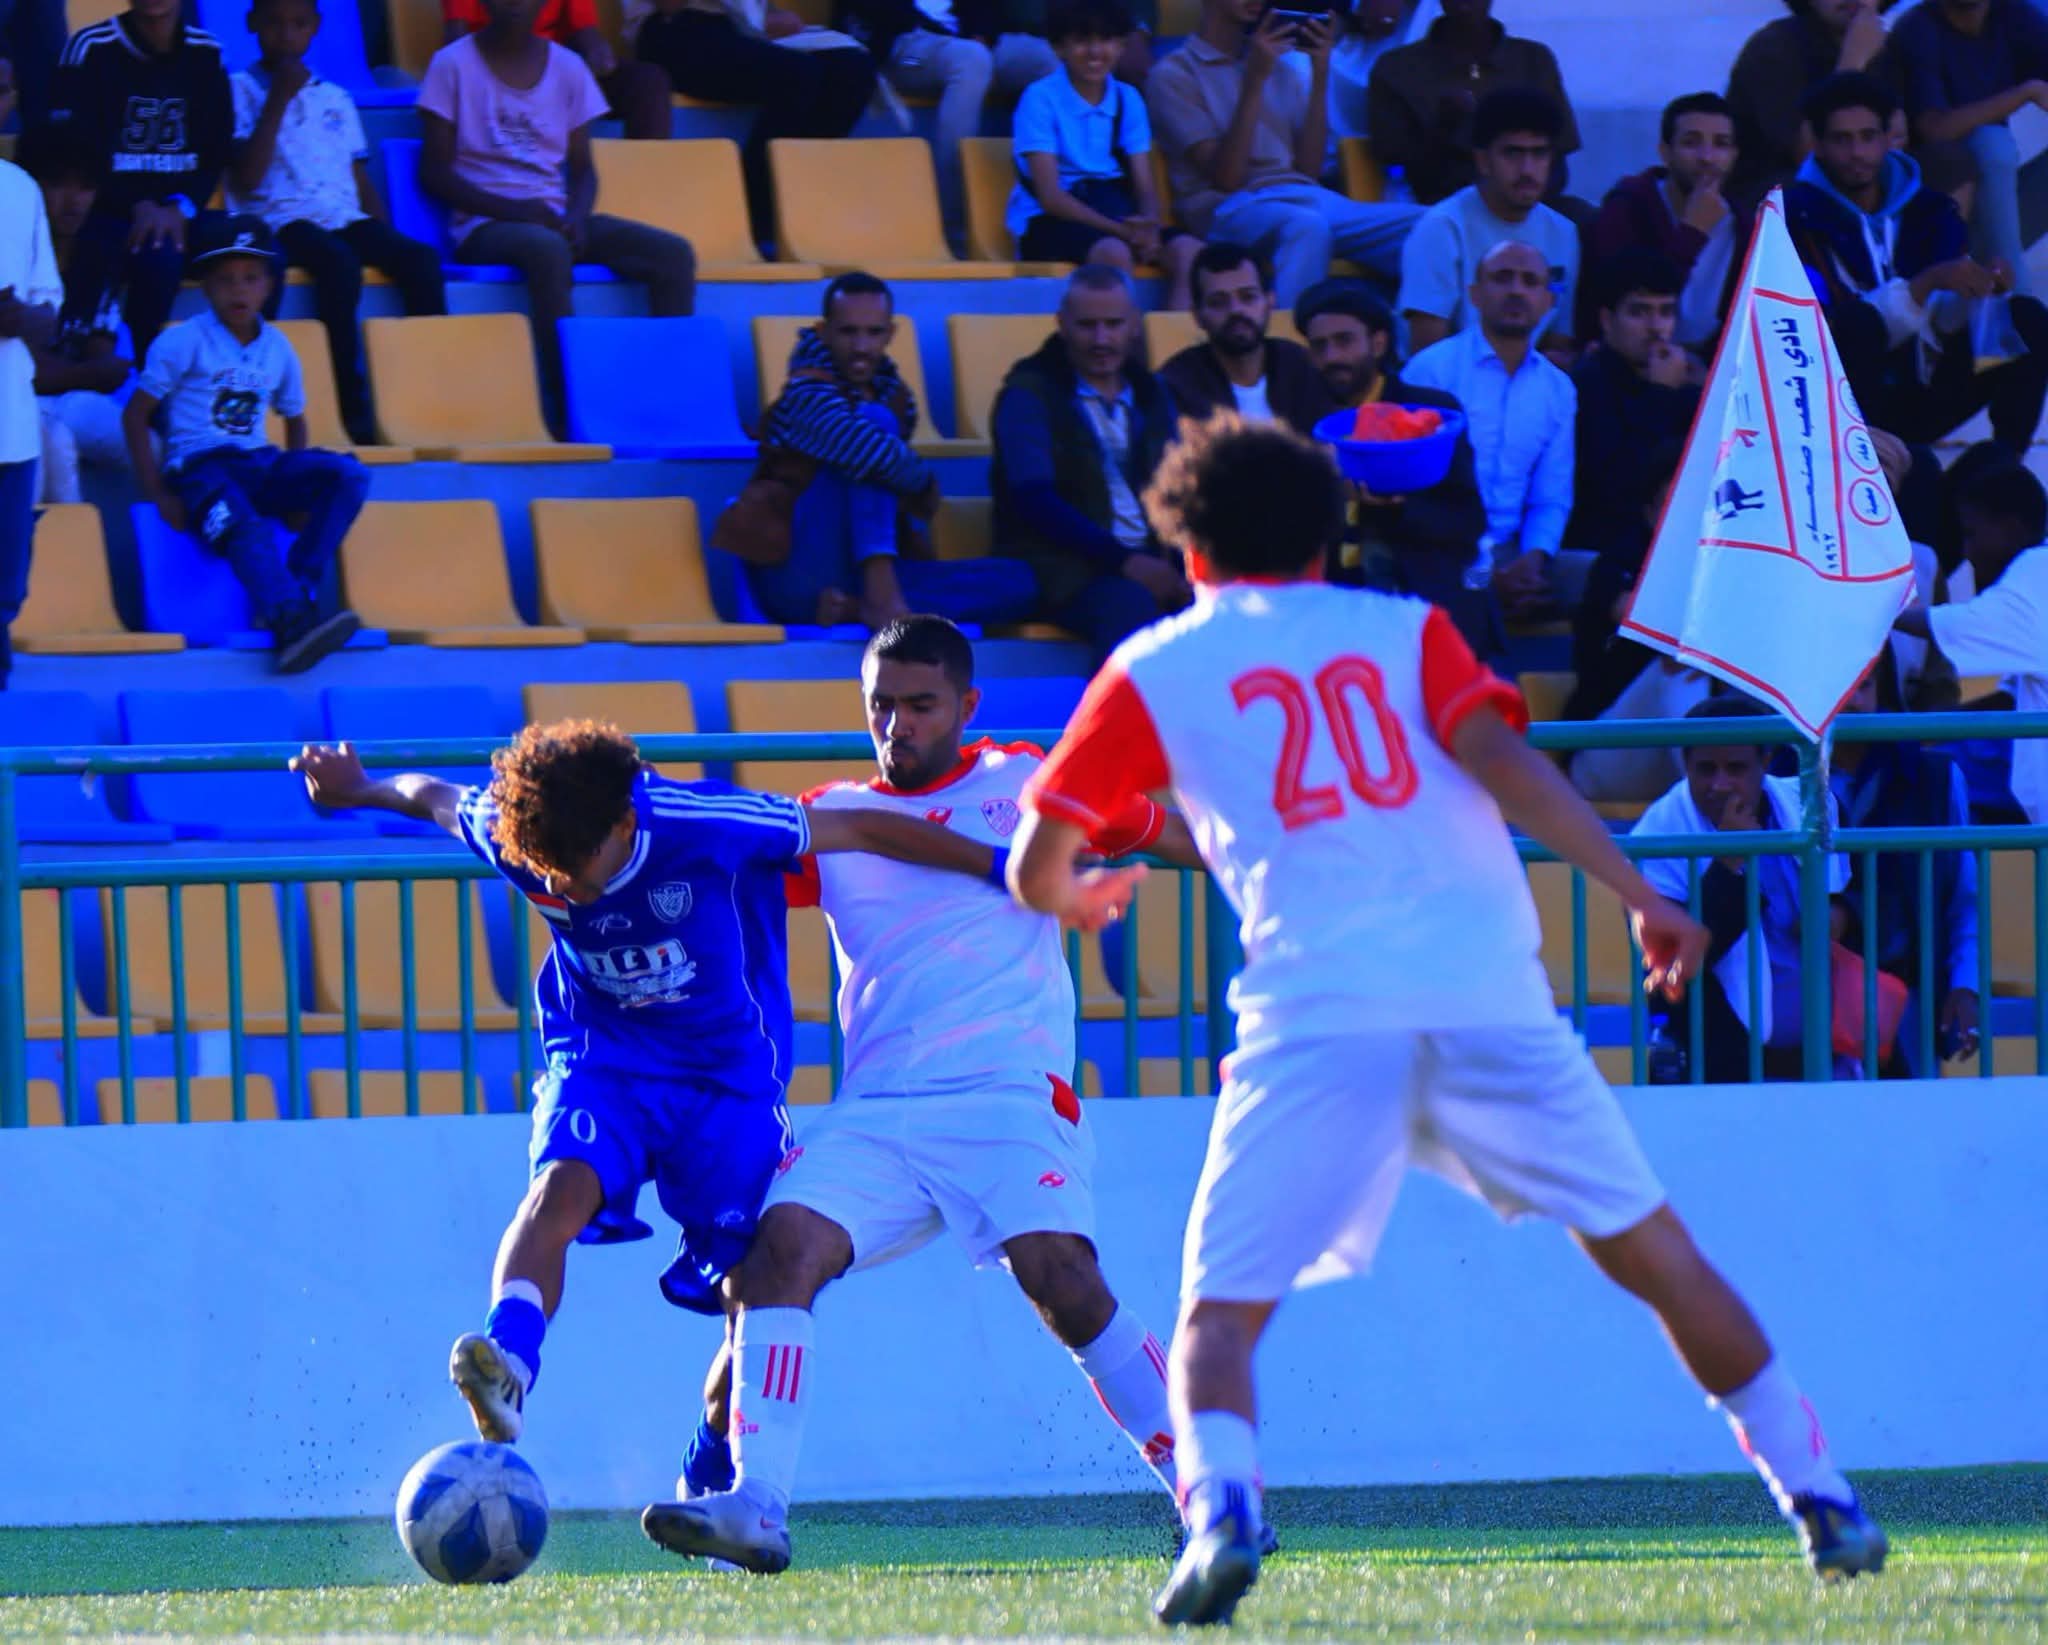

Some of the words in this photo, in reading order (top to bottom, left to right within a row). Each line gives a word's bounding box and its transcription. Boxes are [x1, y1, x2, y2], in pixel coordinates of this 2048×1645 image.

[1773, 318, 1815, 369] نادي
[1785, 376, 1815, 438] شعب
[1230, 657, 1419, 833] 20
[547, 1106, 597, 1144] 70
